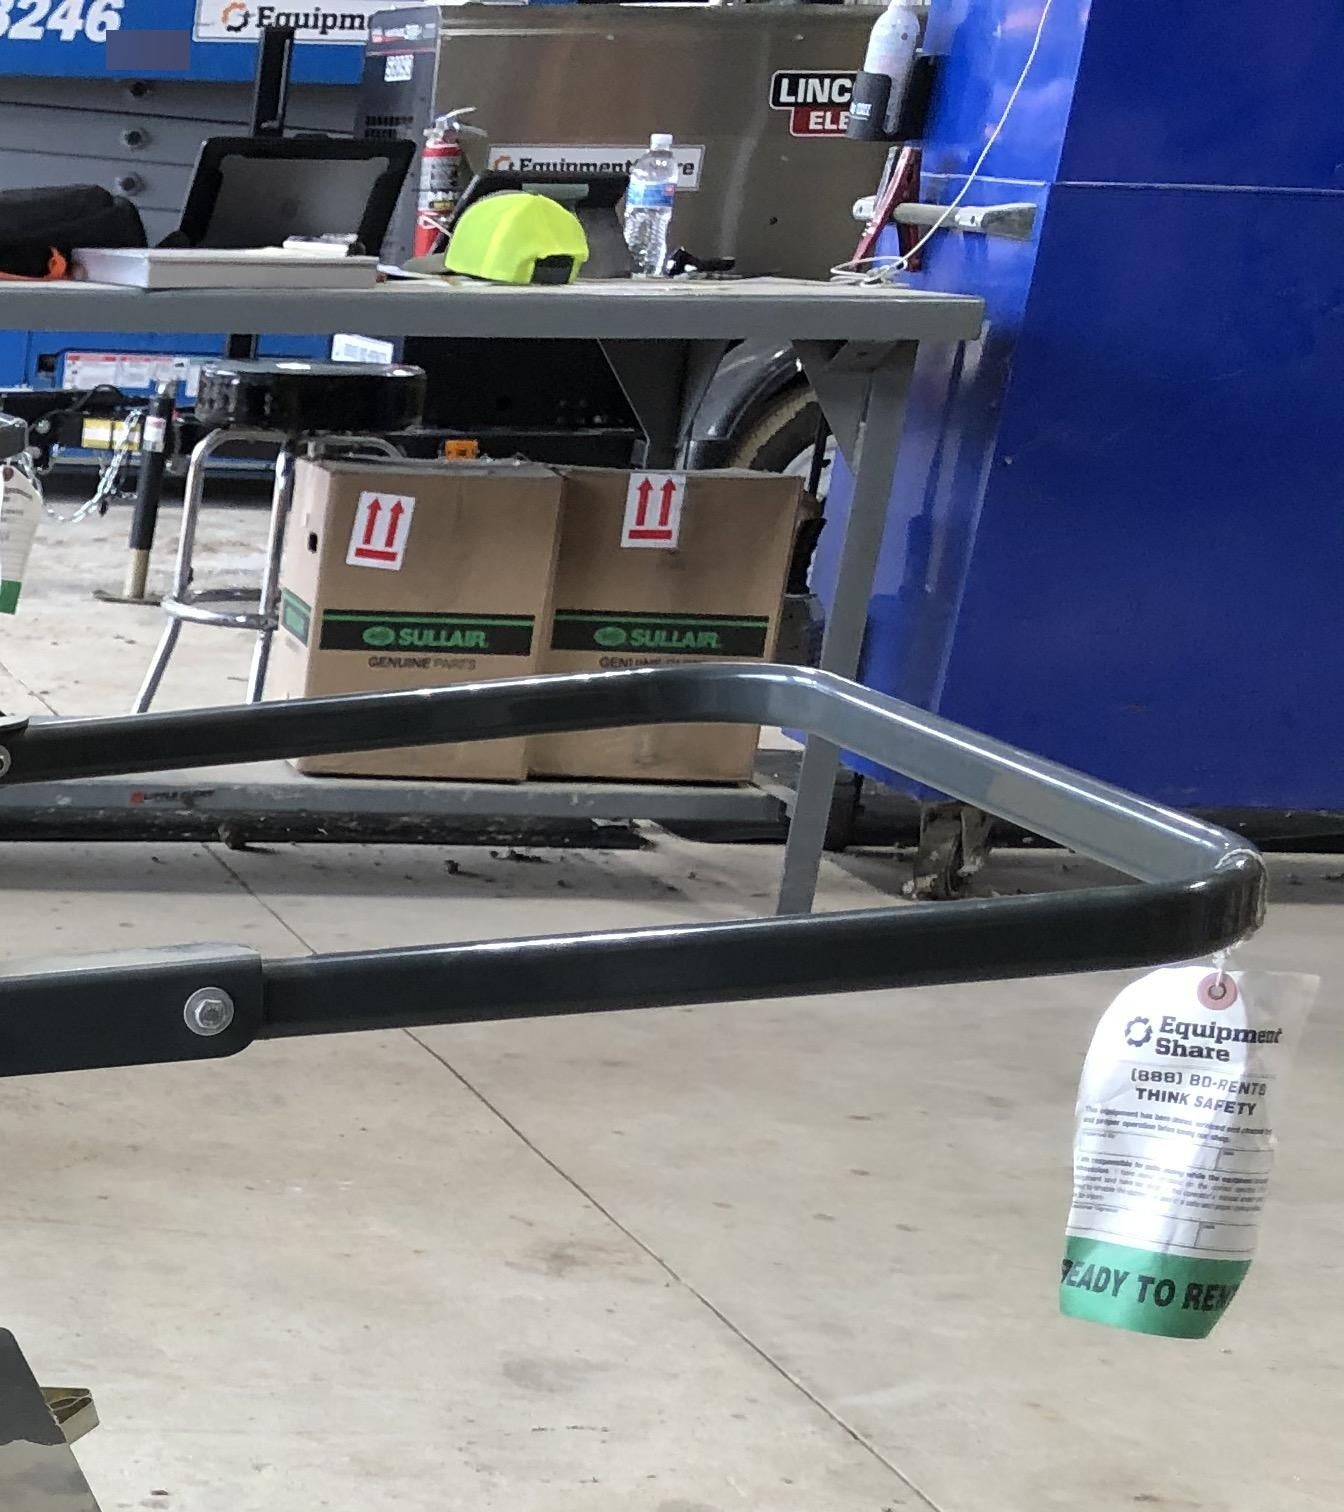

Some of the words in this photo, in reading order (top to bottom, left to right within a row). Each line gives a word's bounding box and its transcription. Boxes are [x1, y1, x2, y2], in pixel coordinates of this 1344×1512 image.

[255, 6, 371, 35] Equipm
[778, 77, 853, 103] LINC
[398, 627, 487, 648] SULLAIR
[629, 628, 720, 648] SULLAIR
[367, 655, 430, 669] GENUINE
[1159, 1015, 1282, 1044] Equipment
[1155, 1037, 1230, 1062] Share
[1130, 1068, 1183, 1084] (888)
[1135, 1087, 1191, 1106] THINK
[1194, 1095, 1257, 1116] SAFETY
[1138, 1273, 1176, 1308] TO
[1180, 1282, 1241, 1312] RE
